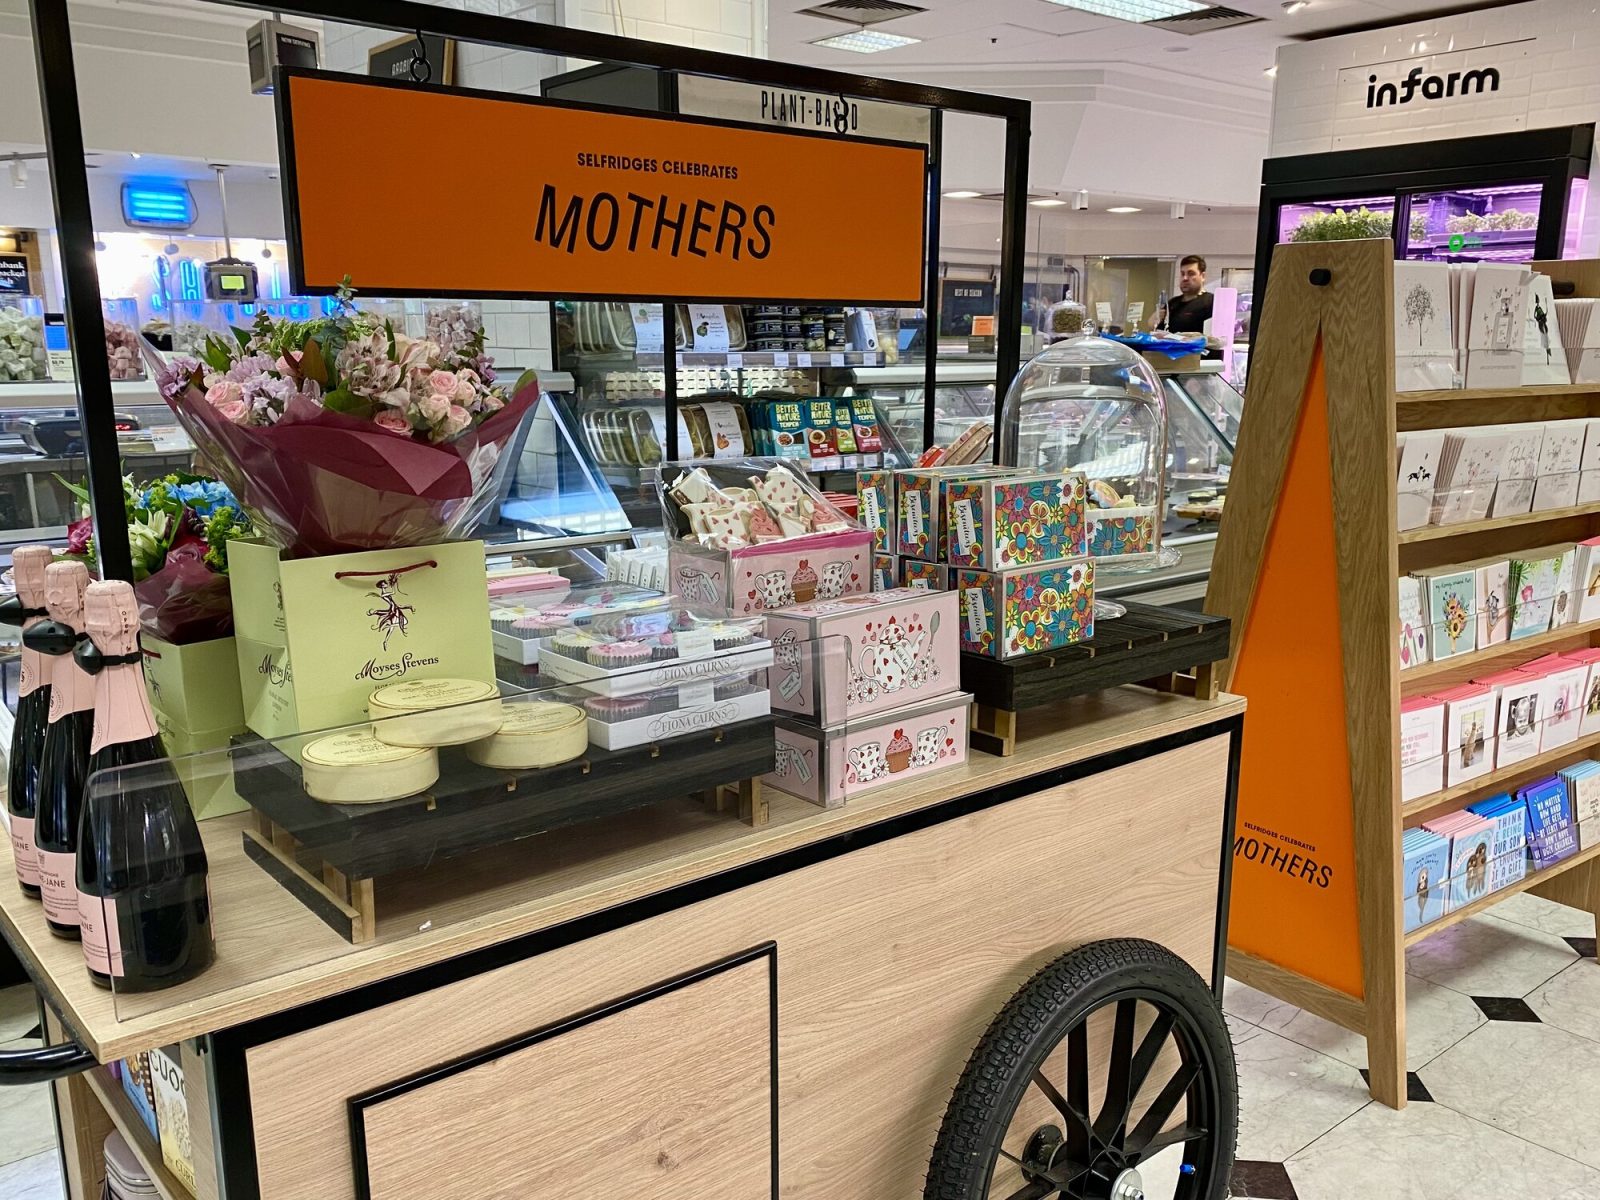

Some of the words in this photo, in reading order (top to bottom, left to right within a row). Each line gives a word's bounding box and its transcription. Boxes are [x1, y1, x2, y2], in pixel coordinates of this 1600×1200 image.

[1366, 66, 1500, 108] infarm
[577, 152, 658, 172] SELFRIDGES
[662, 160, 738, 180] CELEBRATES
[534, 183, 776, 261] MOTHERS
[776, 404, 799, 414] BETTER
[776, 412, 800, 422] NATURE
[810, 401, 832, 410] BETTER
[910, 494, 919, 538] Biscuiteers
[960, 504, 972, 549] Biscuiteers
[971, 592, 982, 637] Biscuiteers
[355, 658, 400, 680] Moyses
[396, 652, 439, 676] Stevens
[663, 664, 692, 681] FIONA
[694, 660, 730, 676] CAIRNS
[661, 716, 690, 733] FIONA
[692, 710, 728, 728] CAIRNS
[1544, 794, 1561, 808] MATTER
[1498, 812, 1522, 830] THINK
[1502, 823, 1522, 839] BEING
[1244, 822, 1278, 839] SELFRIDGES
[1280, 834, 1316, 852] CELEBRATES
